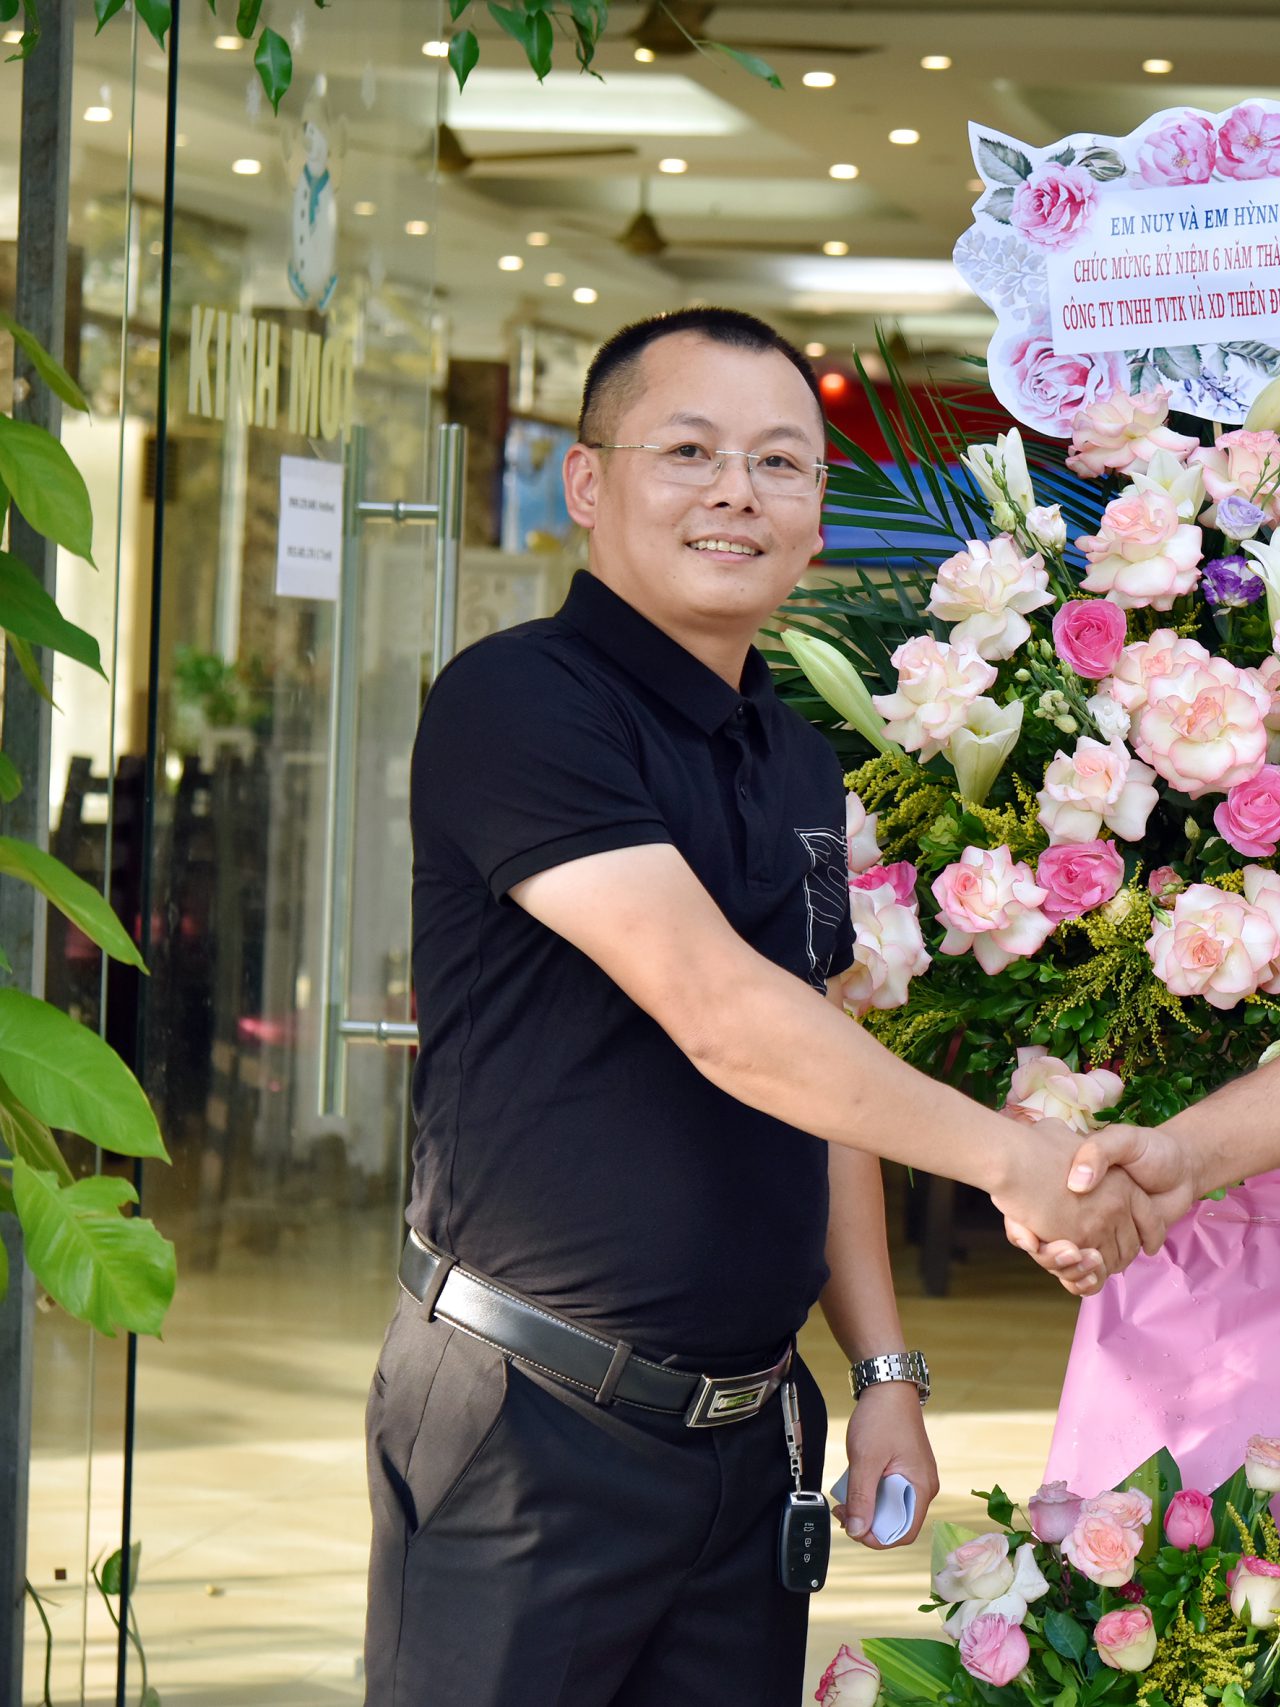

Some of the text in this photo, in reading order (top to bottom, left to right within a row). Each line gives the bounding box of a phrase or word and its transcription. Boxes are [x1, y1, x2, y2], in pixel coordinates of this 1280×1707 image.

[1110, 215, 1136, 236] EM
[1140, 212, 1175, 234] NUY
[1178, 204, 1199, 231] VÀ
[1204, 207, 1229, 229] EM
[1073, 251, 1108, 283] CHÚC
[1111, 248, 1151, 280] MỪNG
[1155, 243, 1172, 276] KỶ
[1175, 242, 1209, 280] NIỆM
[1212, 247, 1220, 272] 6
[1224, 239, 1253, 271] NĂM
[1062, 295, 1096, 331] CÔNG
[1099, 301, 1114, 328] TY
[1117, 298, 1153, 326] TNHH
[1155, 295, 1187, 323] TVTK
[1189, 284, 1206, 321] VÀ
[1207, 293, 1225, 319] XD
[1227, 281, 1266, 317] THIÊN
